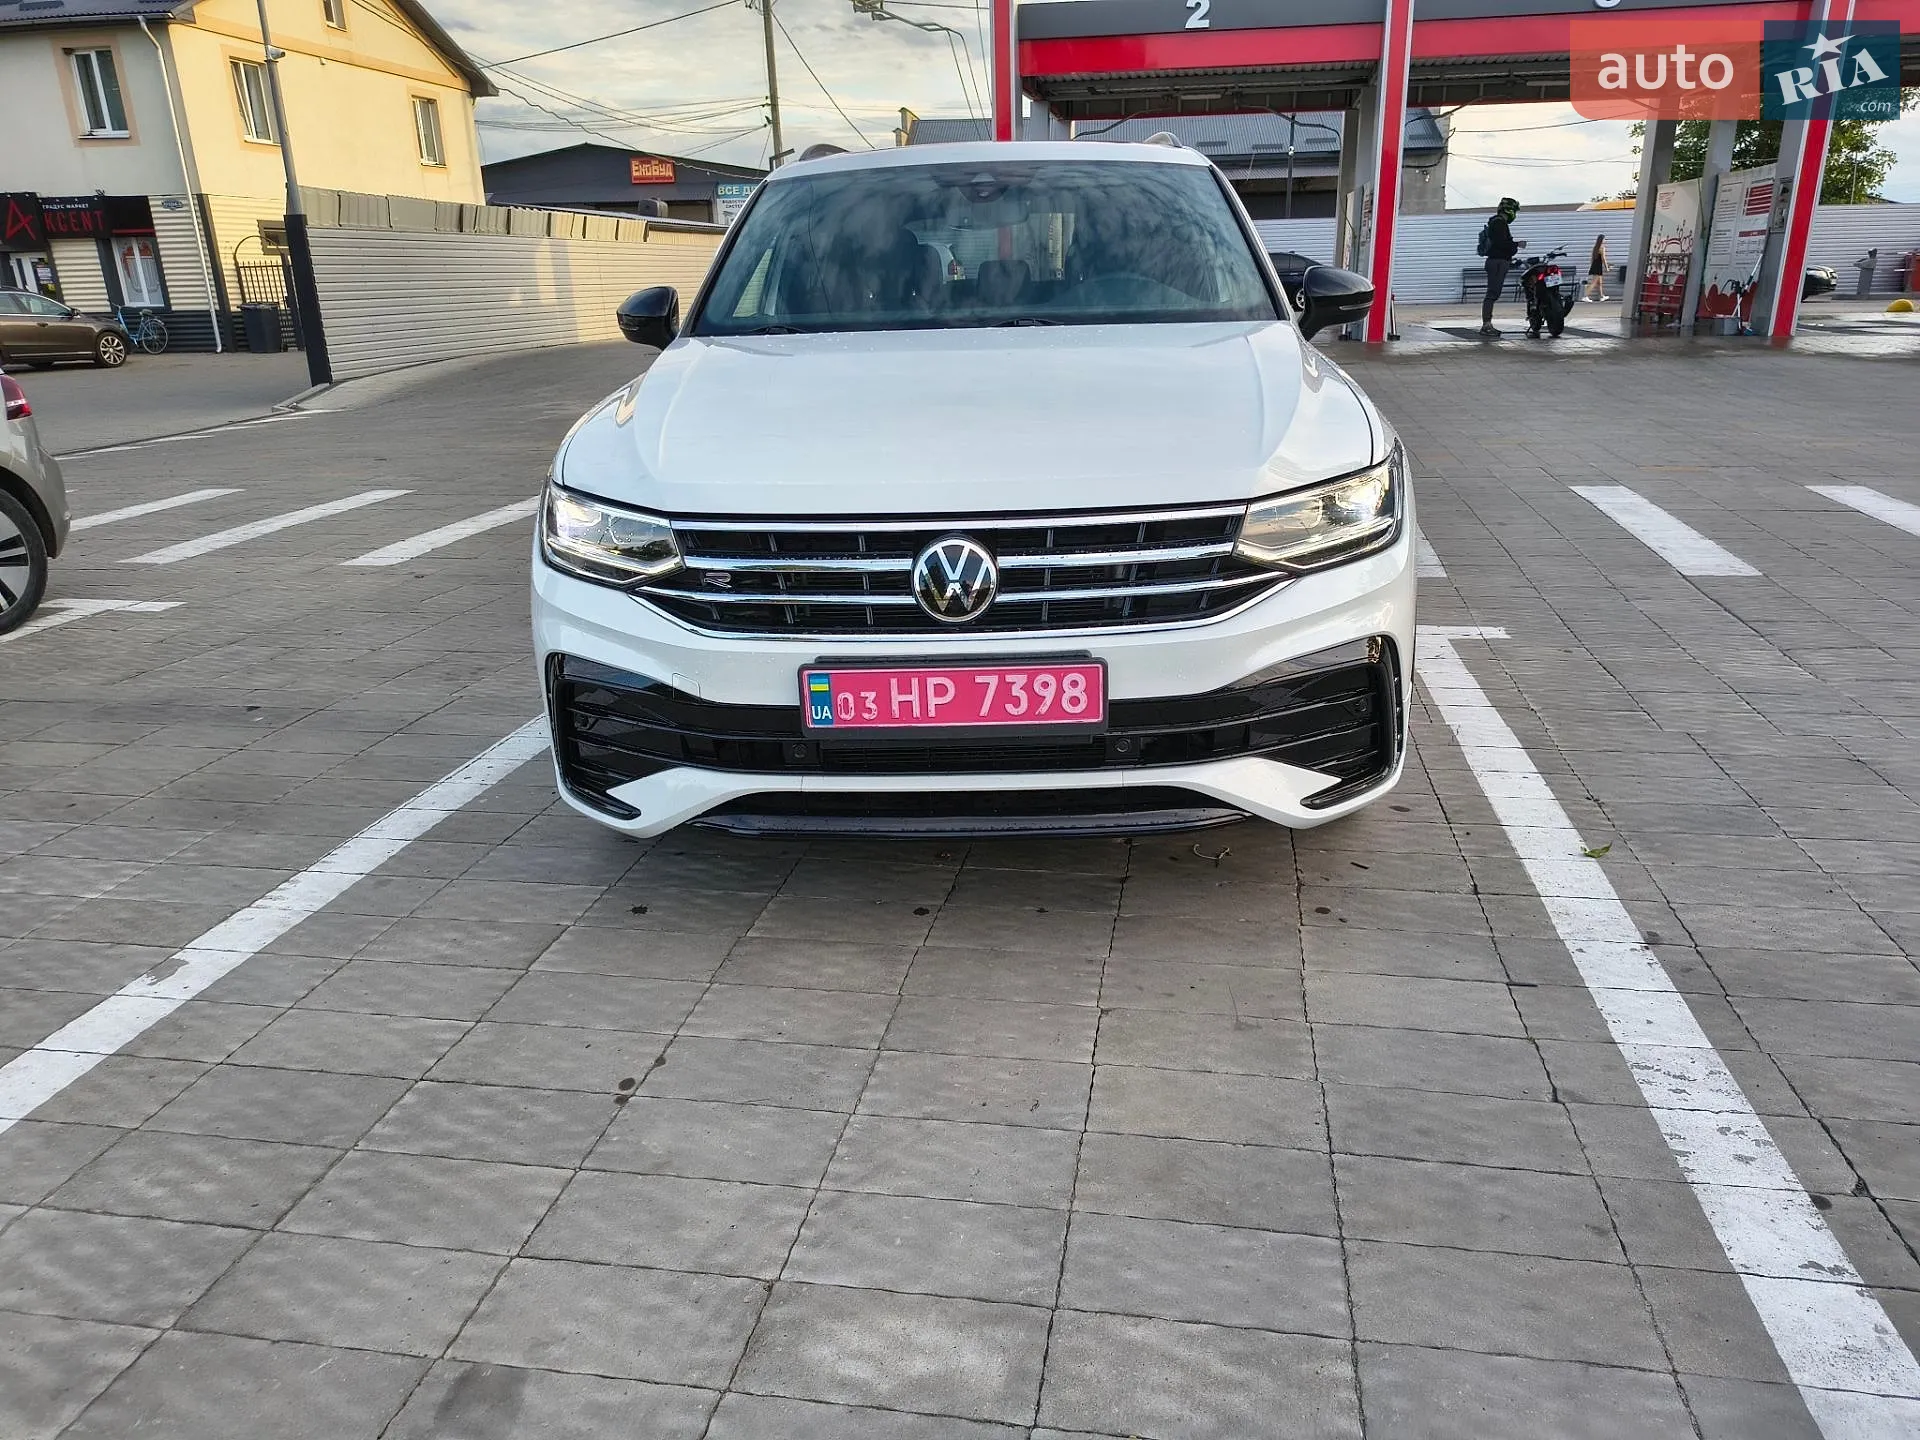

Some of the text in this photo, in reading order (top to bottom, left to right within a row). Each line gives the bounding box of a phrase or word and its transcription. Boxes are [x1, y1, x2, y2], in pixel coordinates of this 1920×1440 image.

[1185, 0, 1210, 28] 2
[717, 185, 740, 196] ВСЕ
[811, 673, 1088, 721] UA 03 HP 7398
